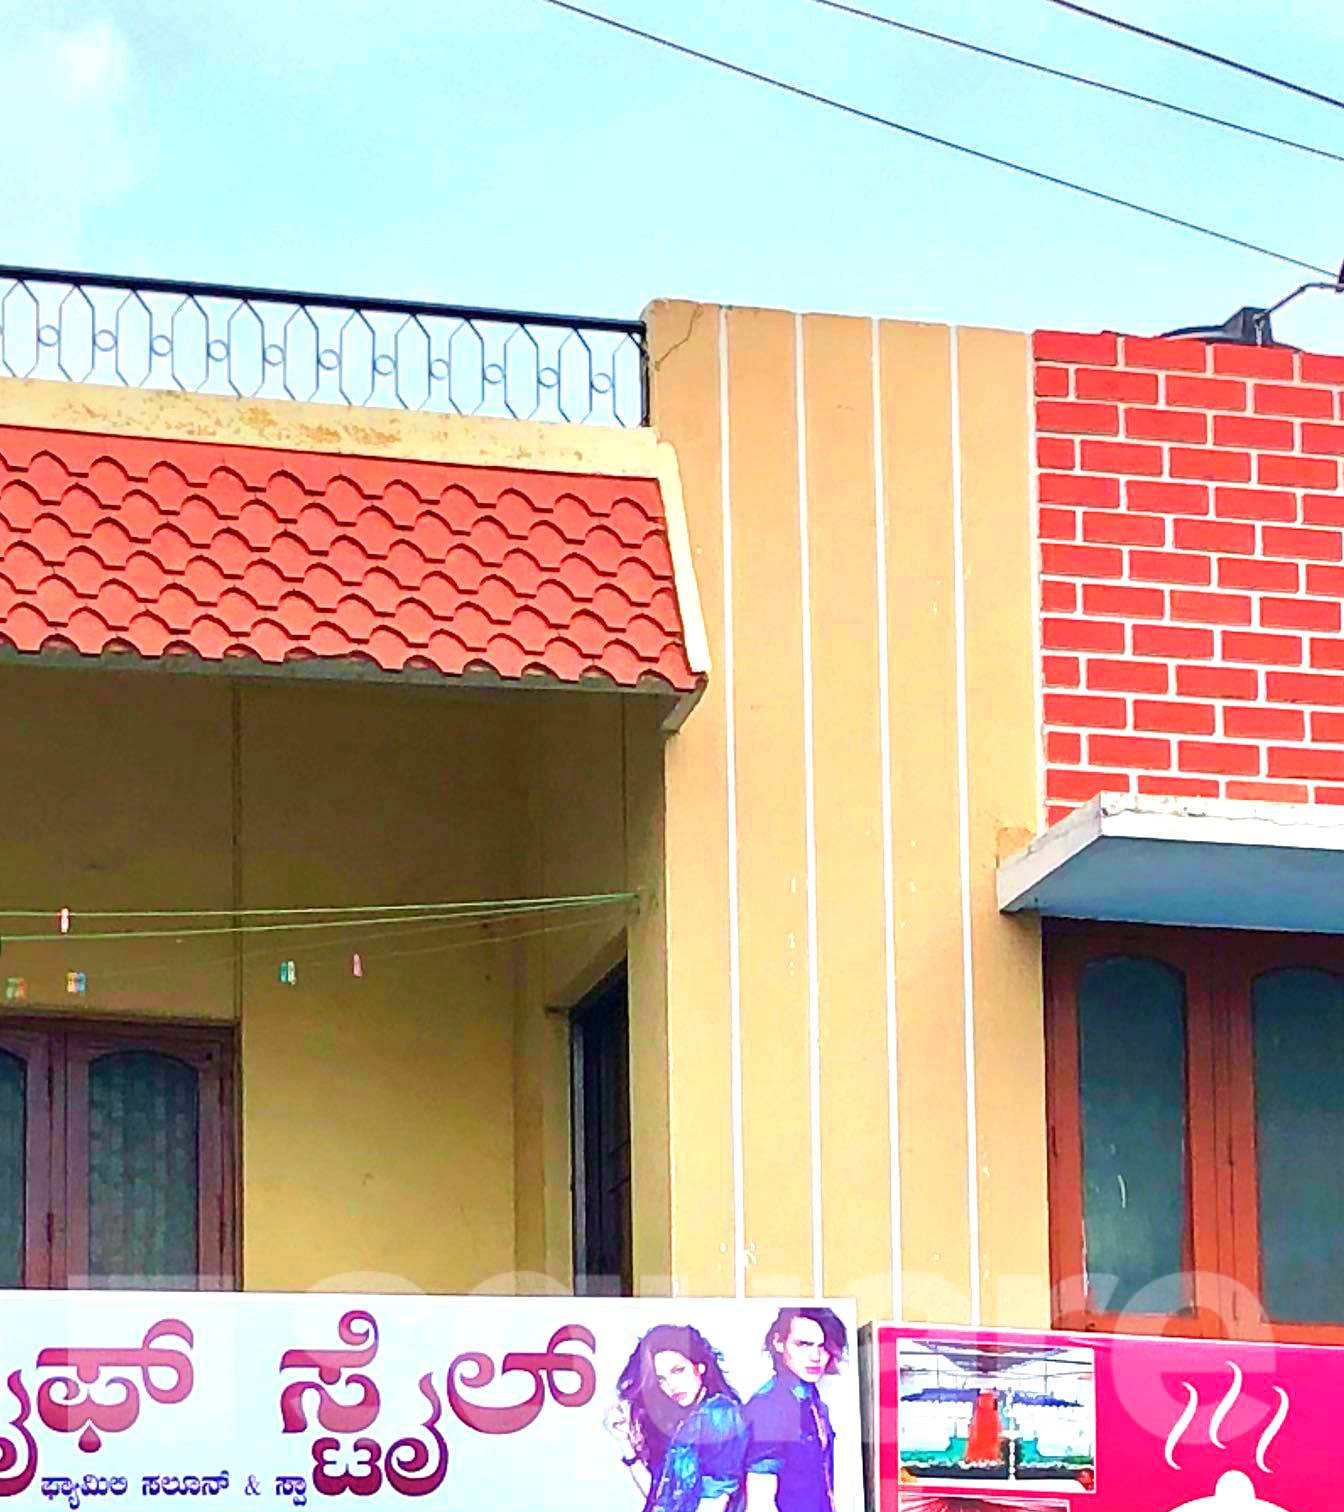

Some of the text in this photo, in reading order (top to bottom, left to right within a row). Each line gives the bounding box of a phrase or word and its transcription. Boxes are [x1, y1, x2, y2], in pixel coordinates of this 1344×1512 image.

[280, 1310, 596, 1497] ಸ್ಟೈಲ್
[41, 1470, 307, 1510] ಫ್ಯಾಮಿಲಿ ಸಲೂನ್ & ಸ್ಪಾ
